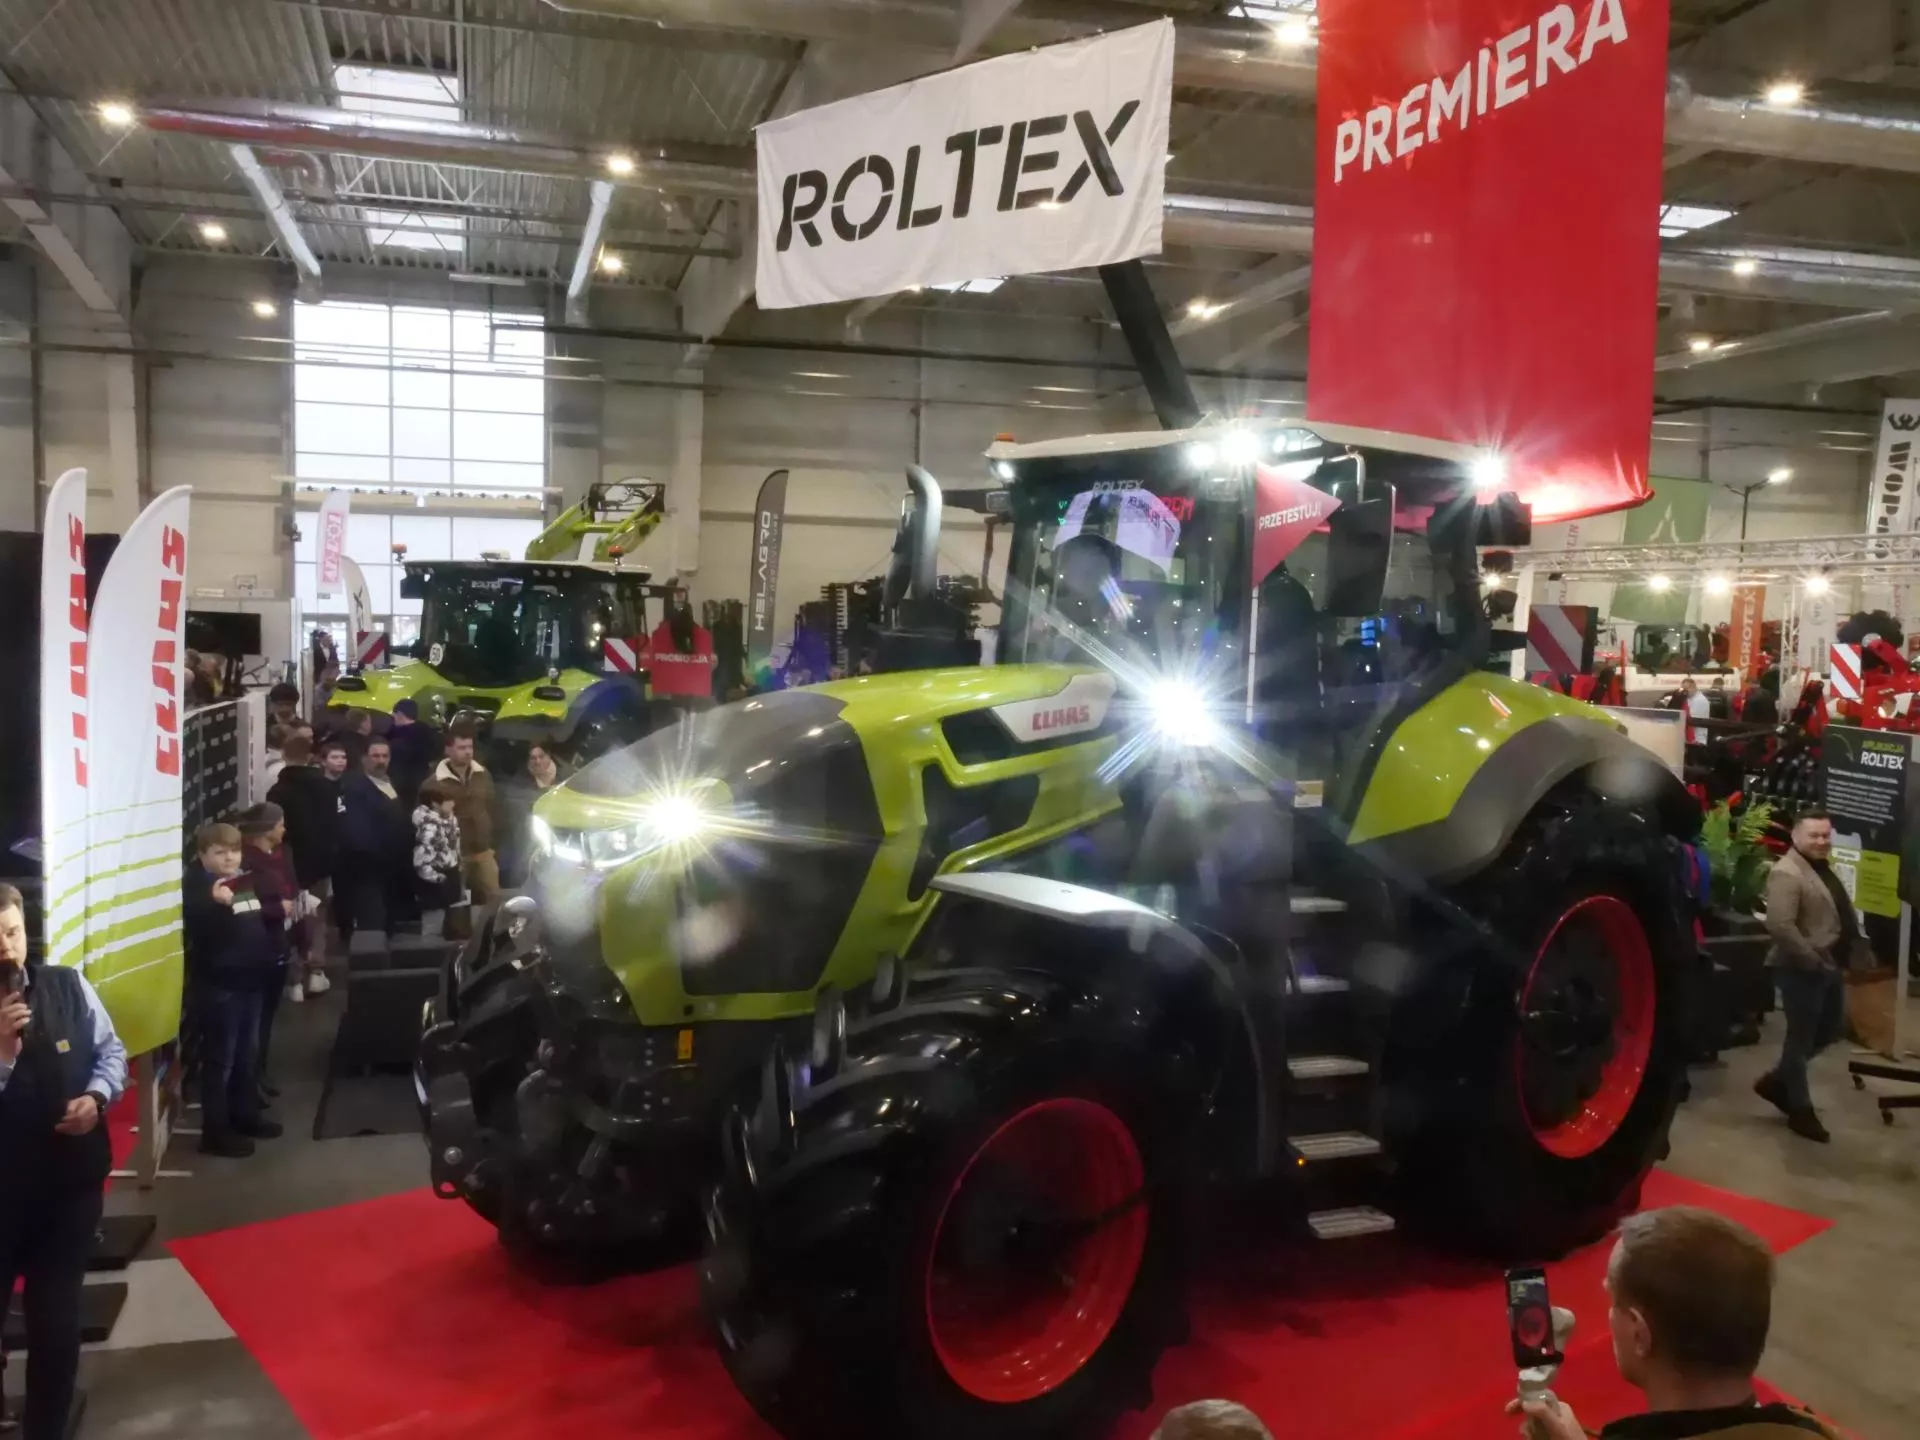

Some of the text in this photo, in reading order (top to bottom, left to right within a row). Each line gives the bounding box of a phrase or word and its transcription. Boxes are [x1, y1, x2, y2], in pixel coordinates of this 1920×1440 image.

[1333, 0, 1629, 184] PREMIERA
[776, 99, 1141, 252] ROLTEX
[1092, 479, 1145, 496] ROLTEX
[1258, 502, 1322, 531] PRZETESTUJ!
[754, 510, 771, 631] HELAGRO
[152, 524, 186, 777] CLAAS
[1738, 587, 1757, 682] AGROTEX
[1031, 704, 1091, 731] CLAAS
[1860, 751, 1906, 771] ROLTEX
